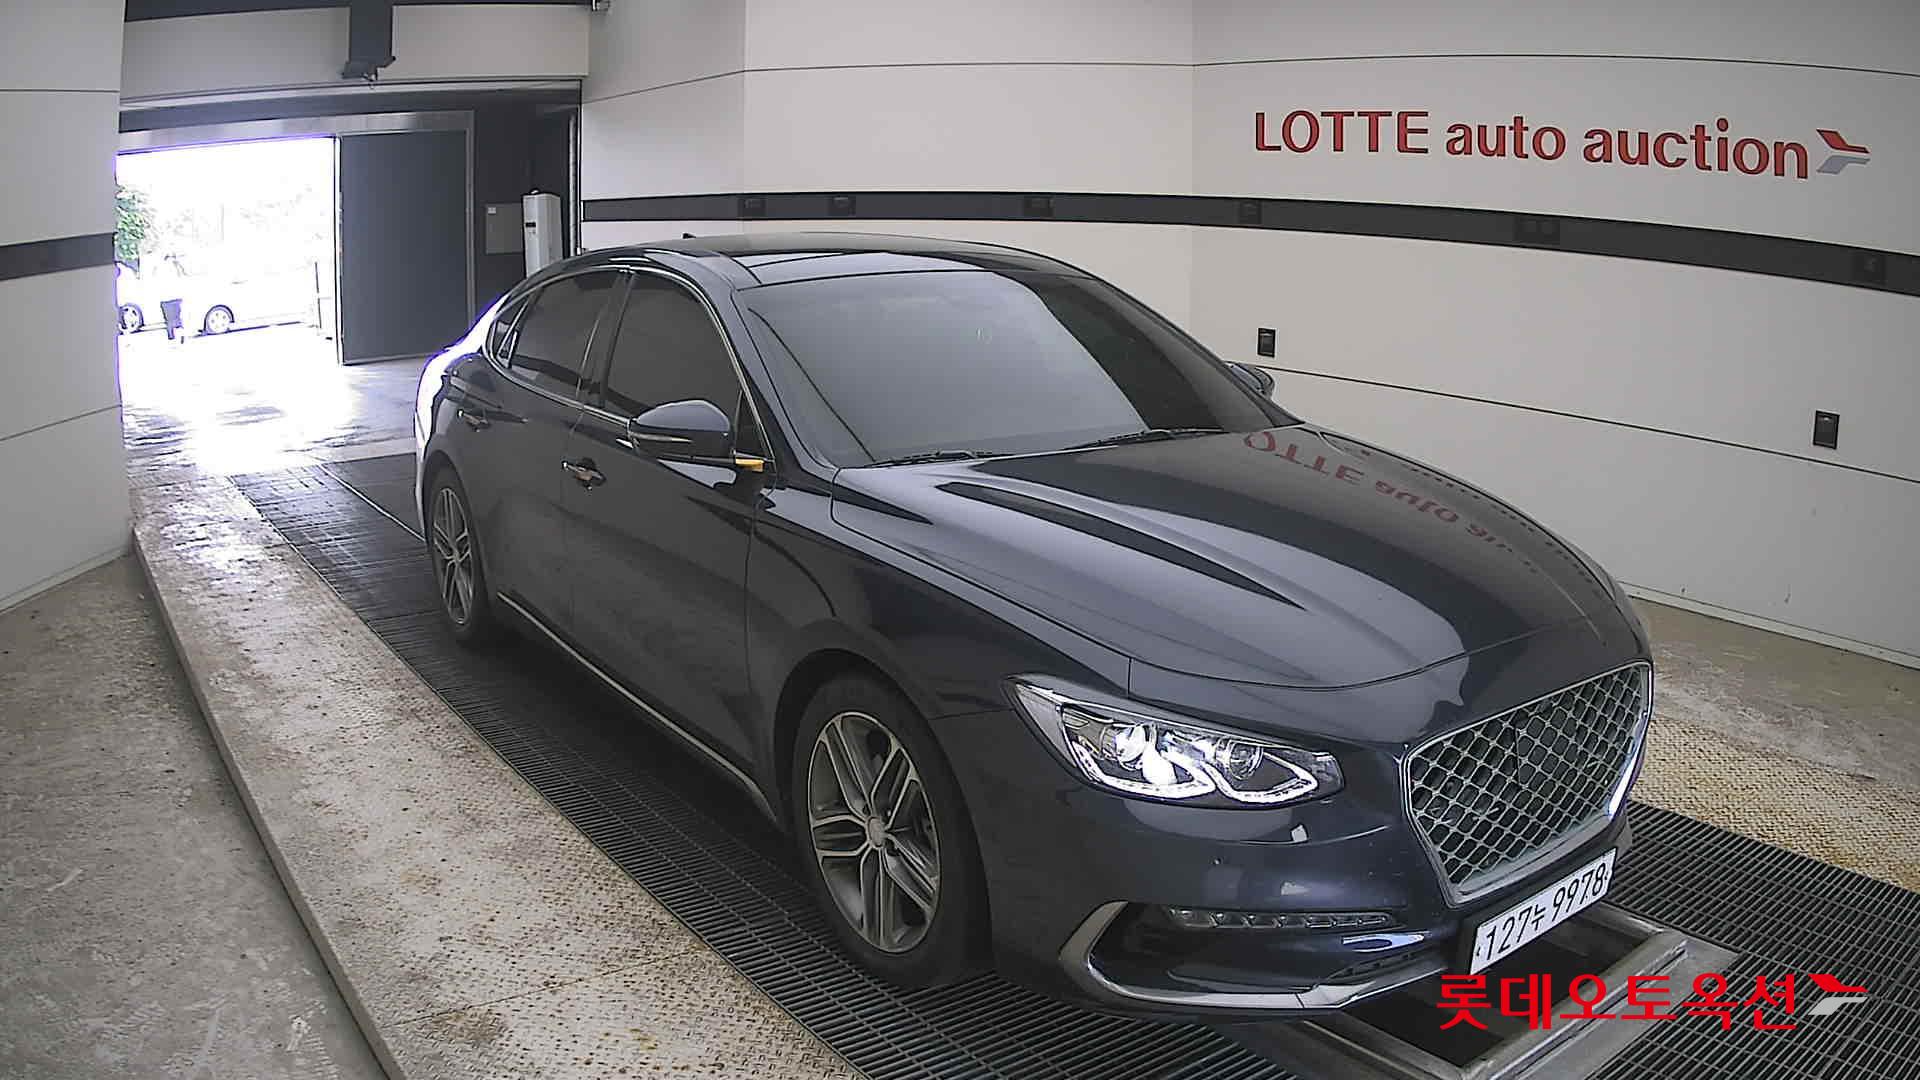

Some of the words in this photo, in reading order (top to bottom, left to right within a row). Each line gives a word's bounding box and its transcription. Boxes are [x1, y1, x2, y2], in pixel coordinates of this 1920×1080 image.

[1255, 110, 1430, 155] LOTTE
[1445, 115, 1568, 162] auto
[1582, 117, 1810, 179] auction
[1486, 903, 1546, 960] 127누
[1551, 862, 1606, 922] 9978
